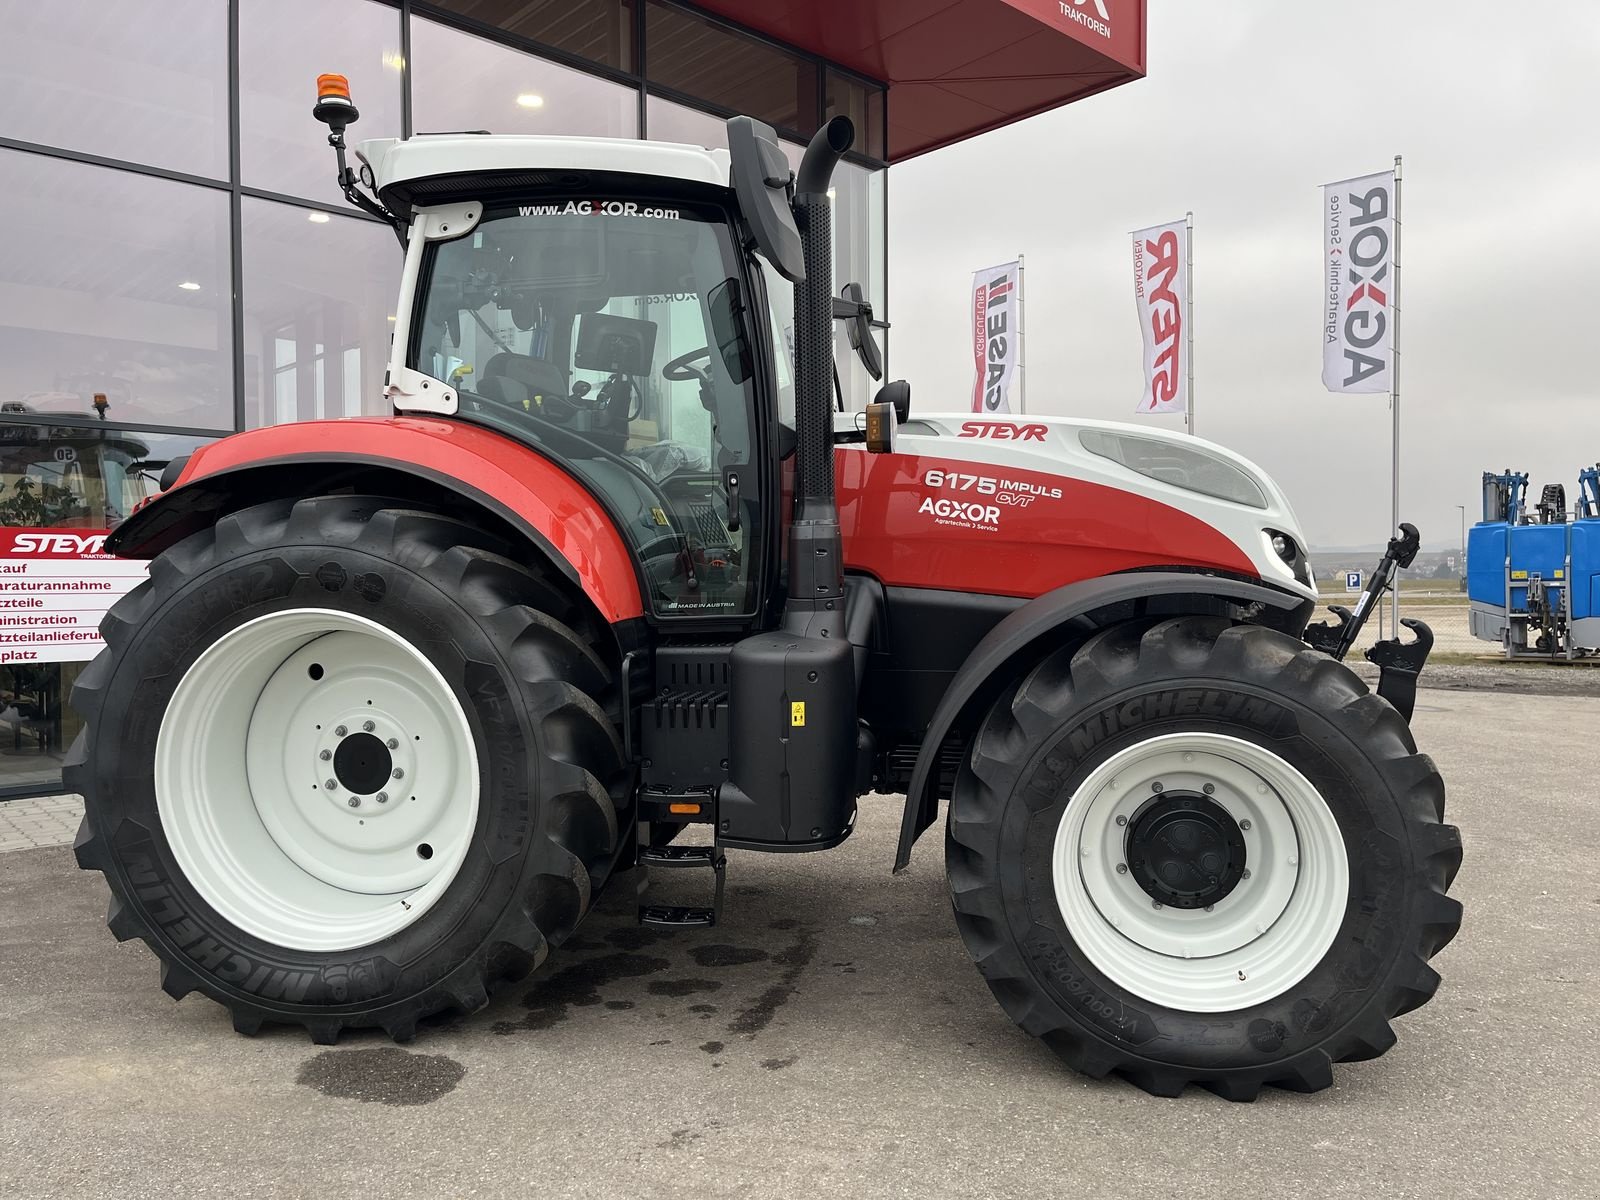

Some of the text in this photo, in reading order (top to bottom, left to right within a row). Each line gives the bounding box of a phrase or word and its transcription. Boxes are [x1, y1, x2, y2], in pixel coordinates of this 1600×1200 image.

[1058, 1, 1111, 39] TRAKTOREN
[518, 200, 680, 220] www.AGXOR.com
[957, 421, 1049, 442] STEYR
[924, 470, 1063, 498] 6175 IMPULS
[995, 491, 1035, 508] CVT
[918, 496, 1001, 525] AGXOR
[934, 518, 999, 532] Agrartechnik Service
[1350, 574, 1358, 586] P
[0, 614, 77, 625] inistration
[0, 630, 102, 642] tzteilanlieferu
[0, 650, 38, 663] platz
[1066, 688, 1285, 757] MICHELIN
[119, 845, 317, 1005] MICHELIN
